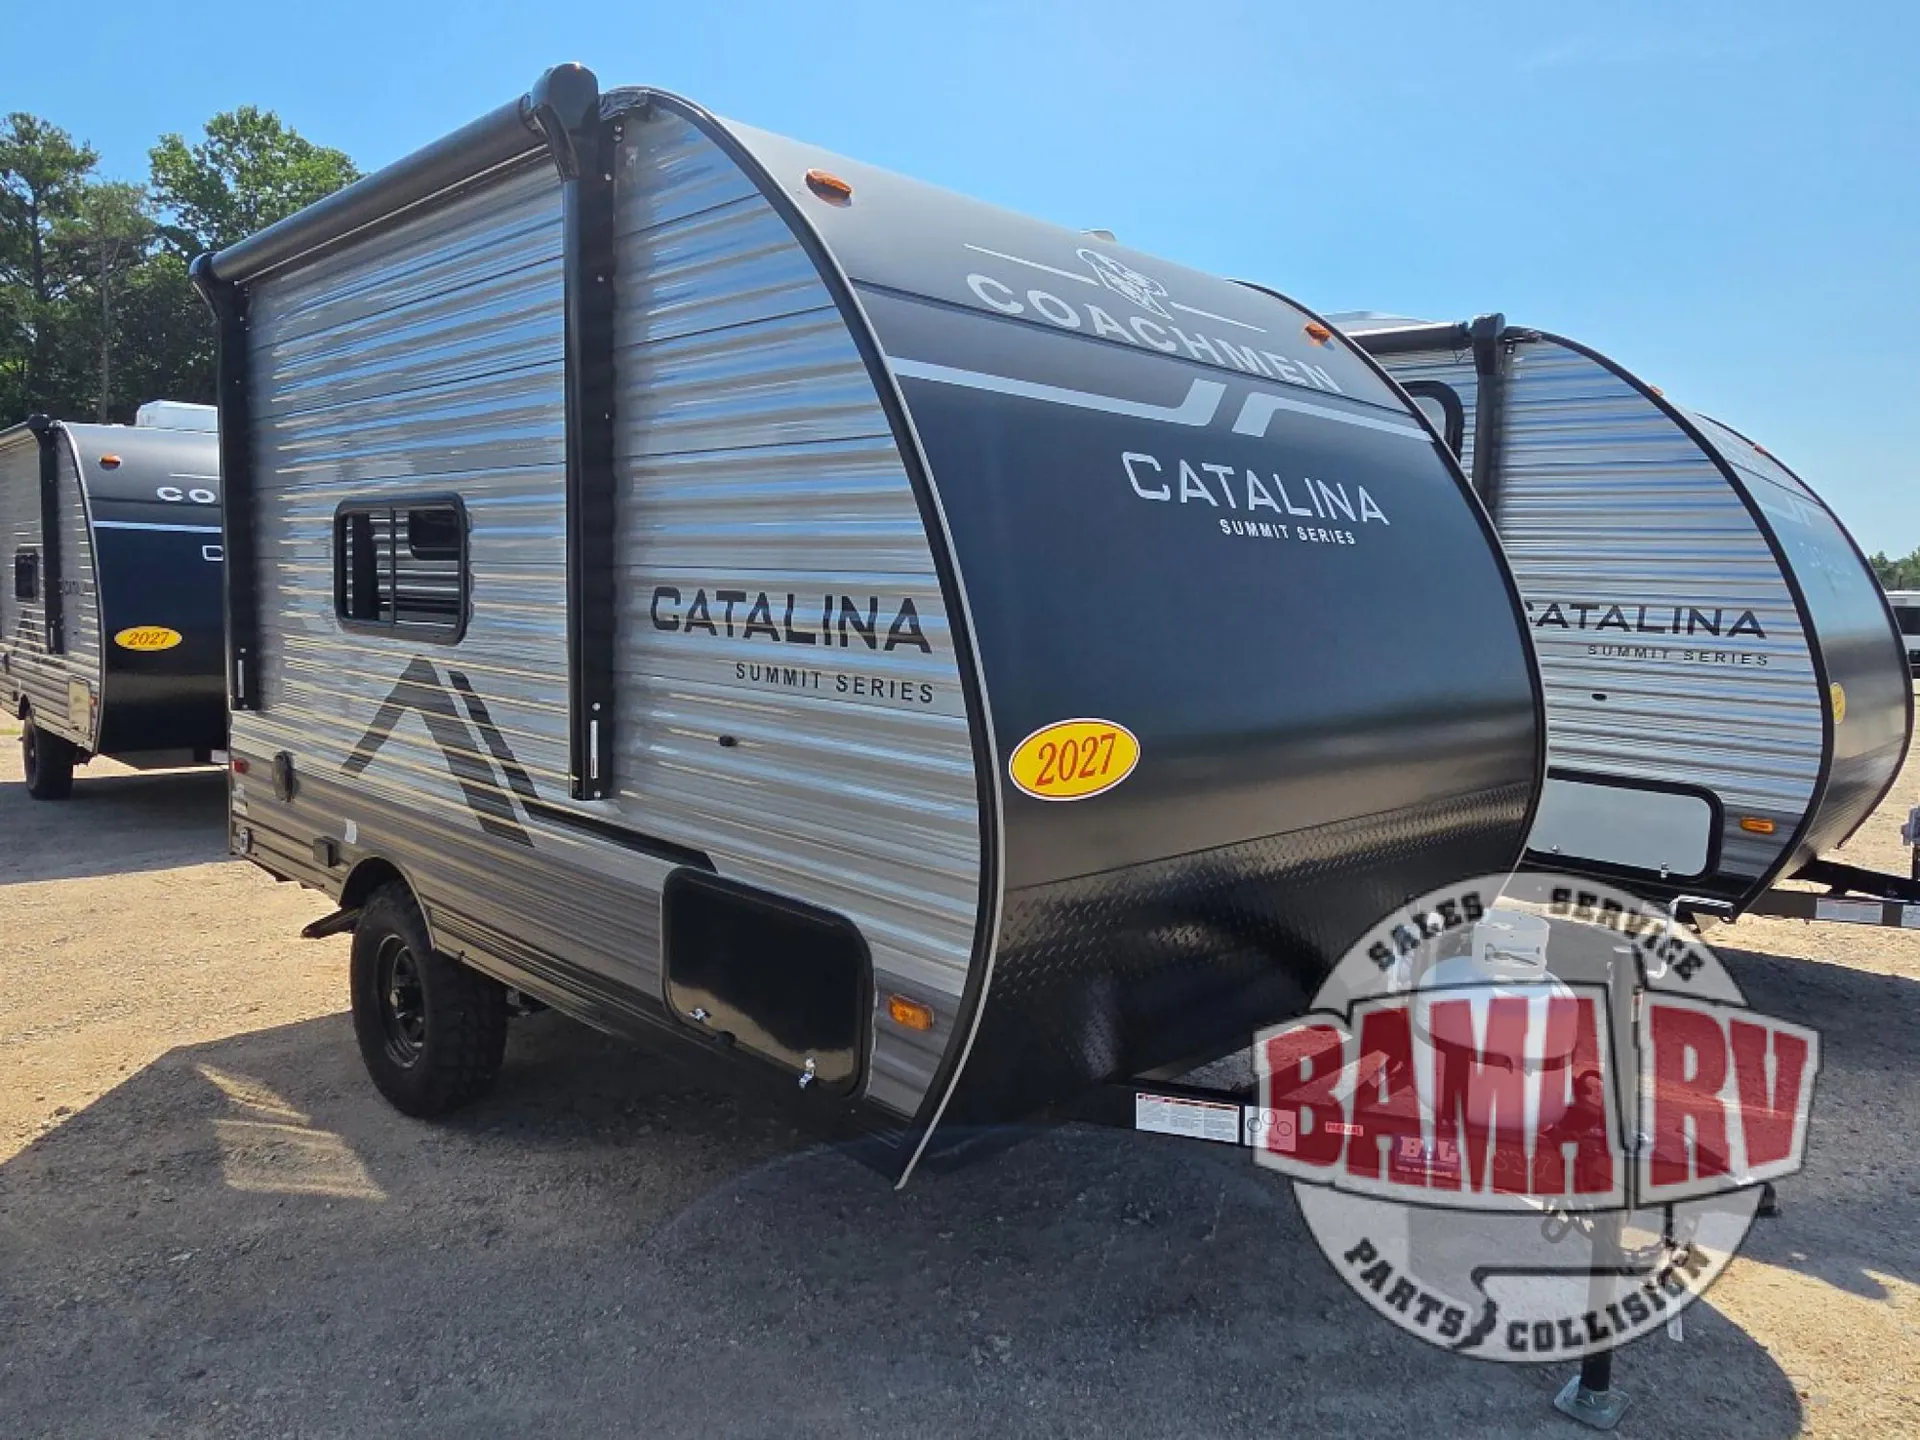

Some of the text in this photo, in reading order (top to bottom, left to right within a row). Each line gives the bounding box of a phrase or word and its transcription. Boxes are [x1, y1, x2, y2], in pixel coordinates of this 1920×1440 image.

[966, 273, 1342, 394] COACHMEN
[1121, 451, 1390, 526] CATALINA
[1219, 518, 1356, 545] SUMMIT SERIES
[127, 631, 169, 646] 2027
[651, 586, 933, 654] CATALINA
[1588, 645, 1768, 666] SUMMIT SERIES
[735, 662, 933, 704] SUMMIT SERIES
[1035, 732, 1116, 787] 2027
